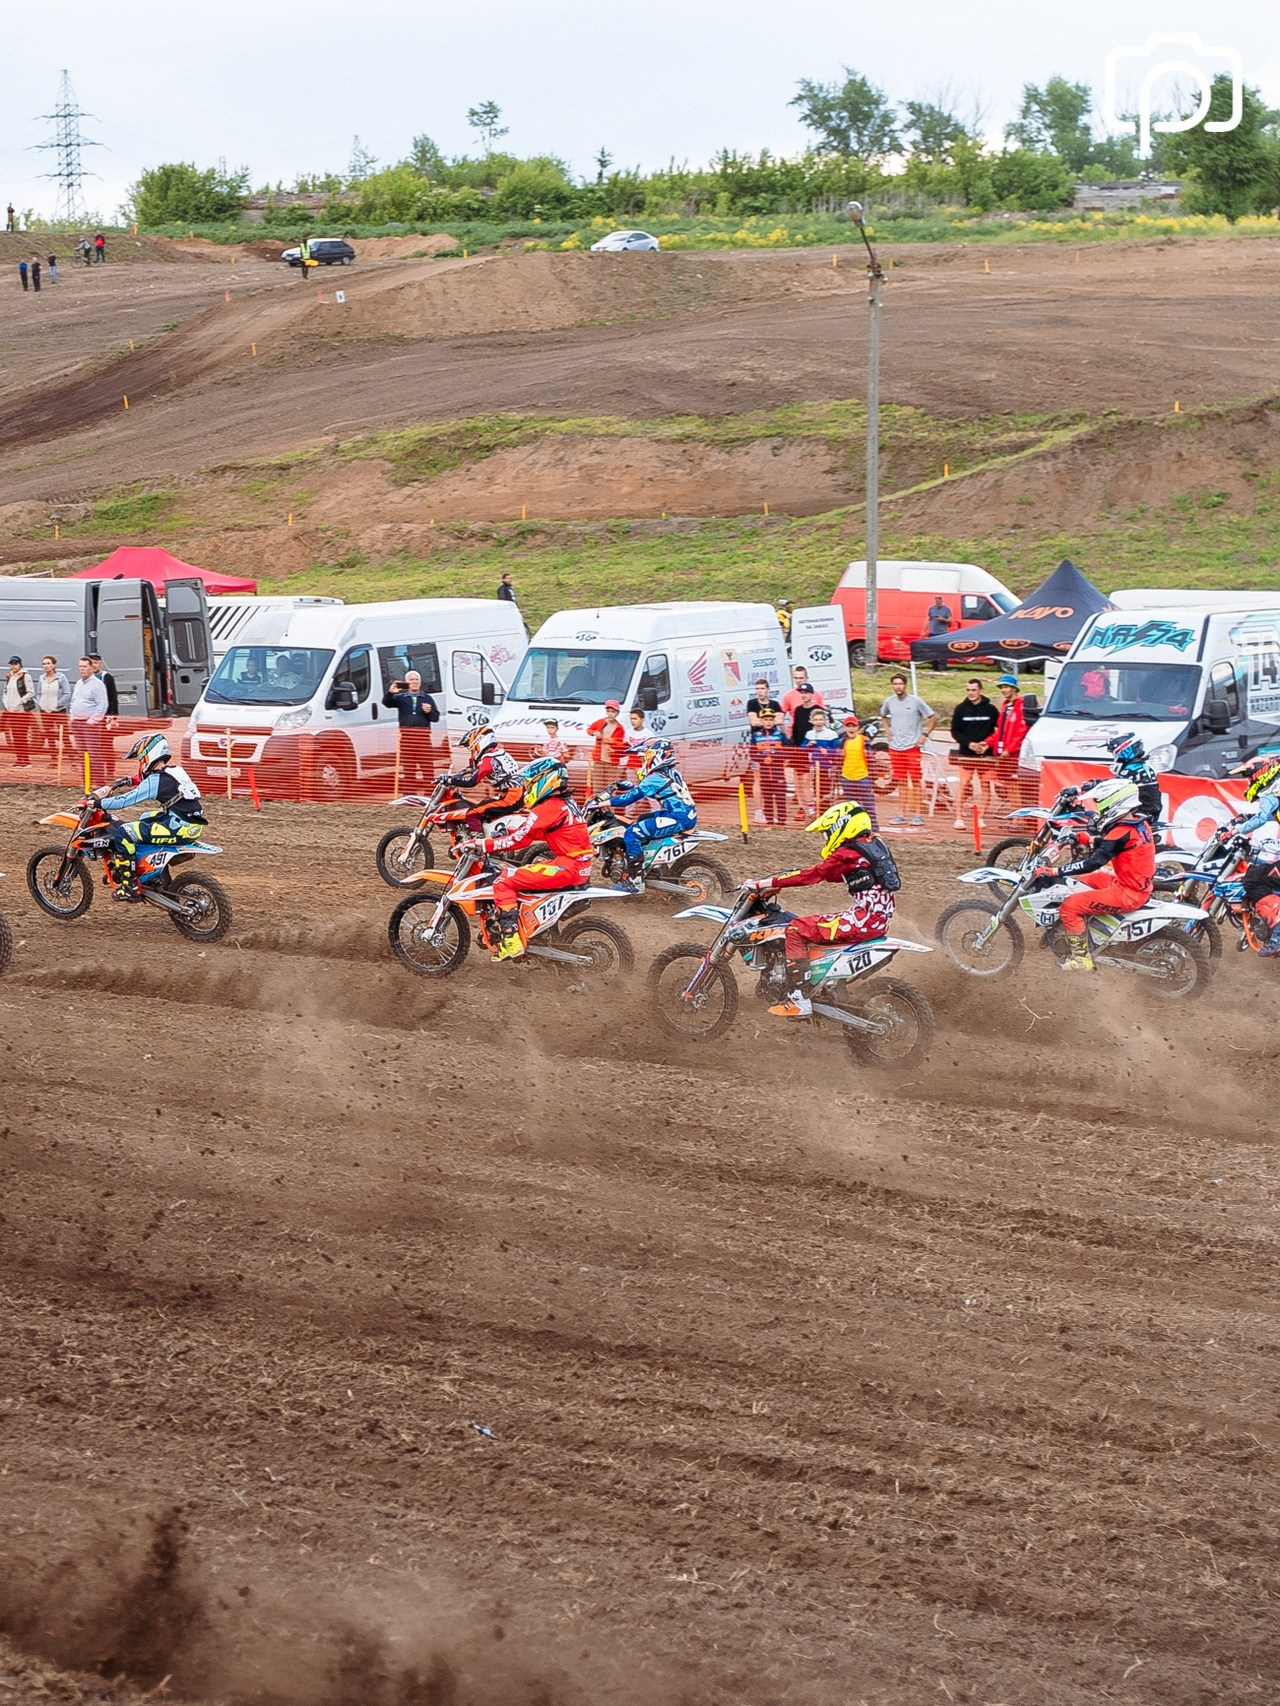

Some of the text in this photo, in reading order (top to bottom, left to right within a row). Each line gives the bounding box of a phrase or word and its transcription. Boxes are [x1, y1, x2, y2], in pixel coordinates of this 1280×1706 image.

[1008, 604, 1075, 621] KAYO
[151, 836, 177, 844] UFO
[1061, 860, 1086, 873] LEATT
[1121, 918, 1153, 940] 757
[847, 951, 871, 975] 120
